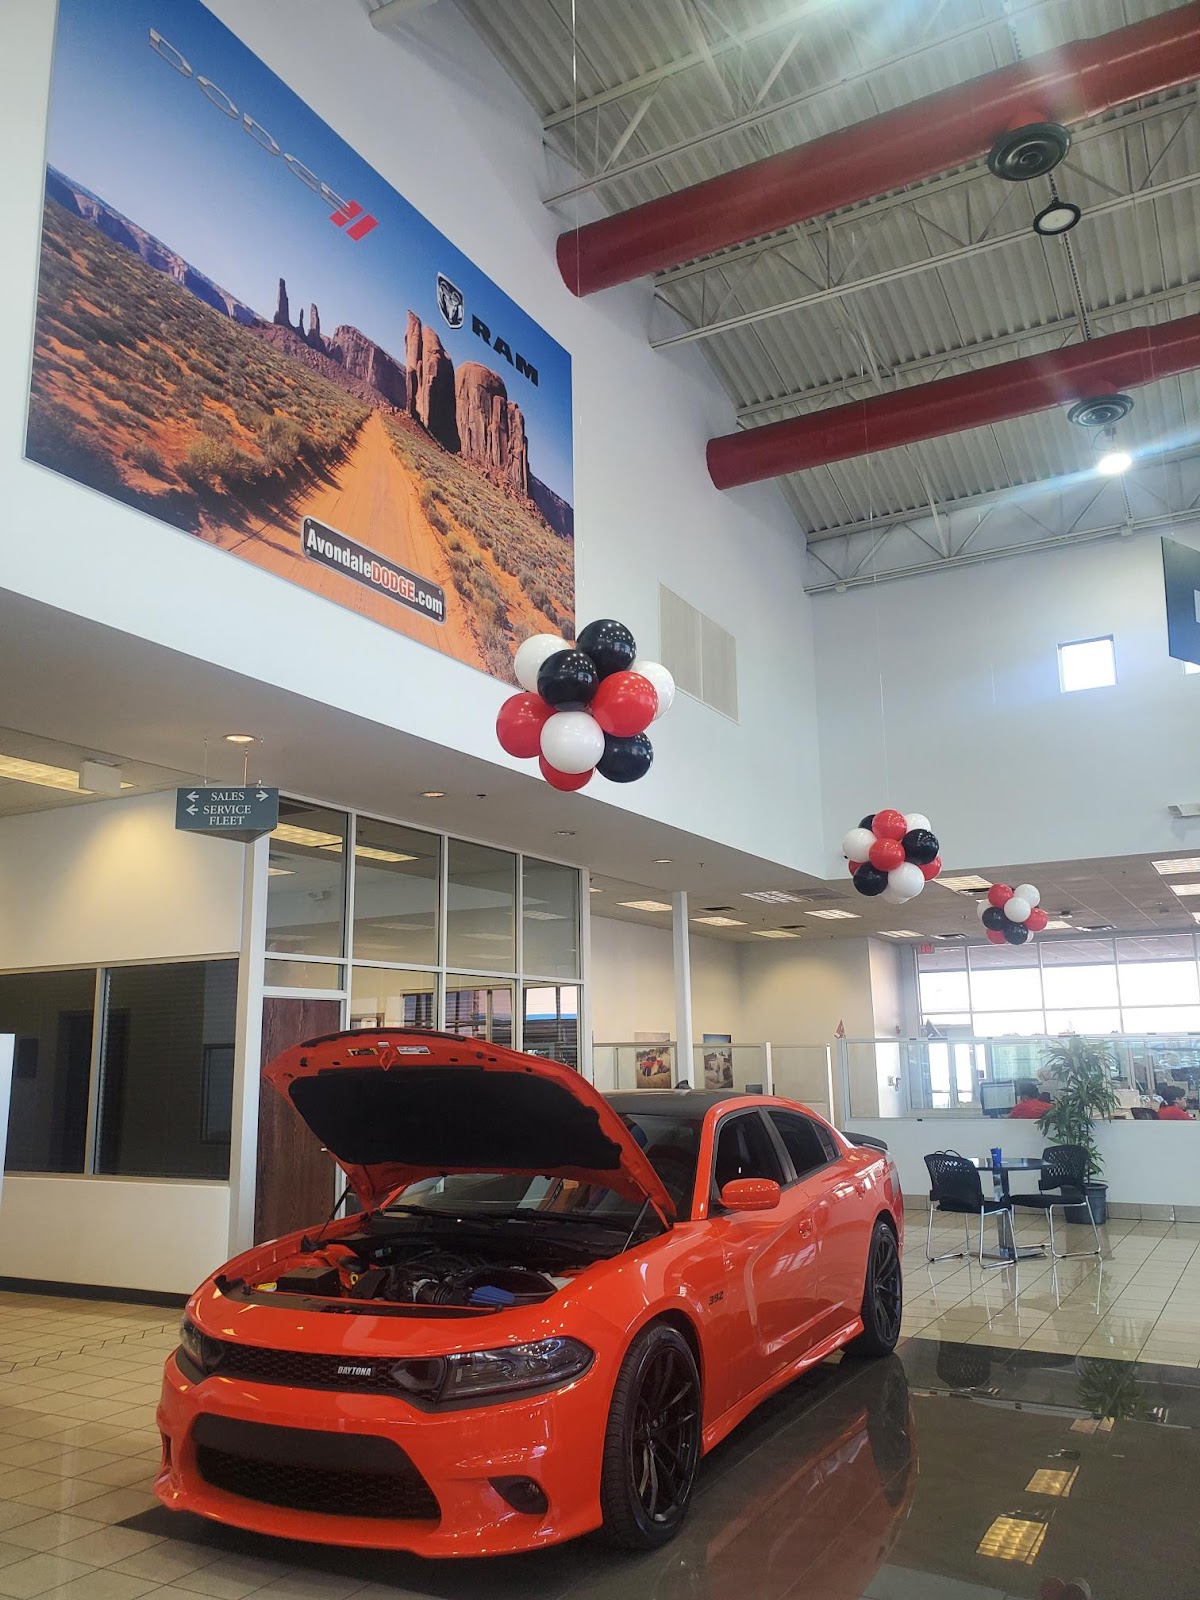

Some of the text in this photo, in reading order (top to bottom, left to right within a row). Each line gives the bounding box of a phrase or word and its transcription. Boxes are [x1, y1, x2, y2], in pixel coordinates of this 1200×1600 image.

[149, 28, 351, 221] DODGE
[472, 314, 538, 387] RAM
[306, 528, 443, 615] AvondaleDODGE.com
[210, 792, 245, 801] SALES
[203, 805, 252, 815] SERVICE
[209, 816, 245, 826] FLEET
[337, 1366, 372, 1376] DAYTONA
